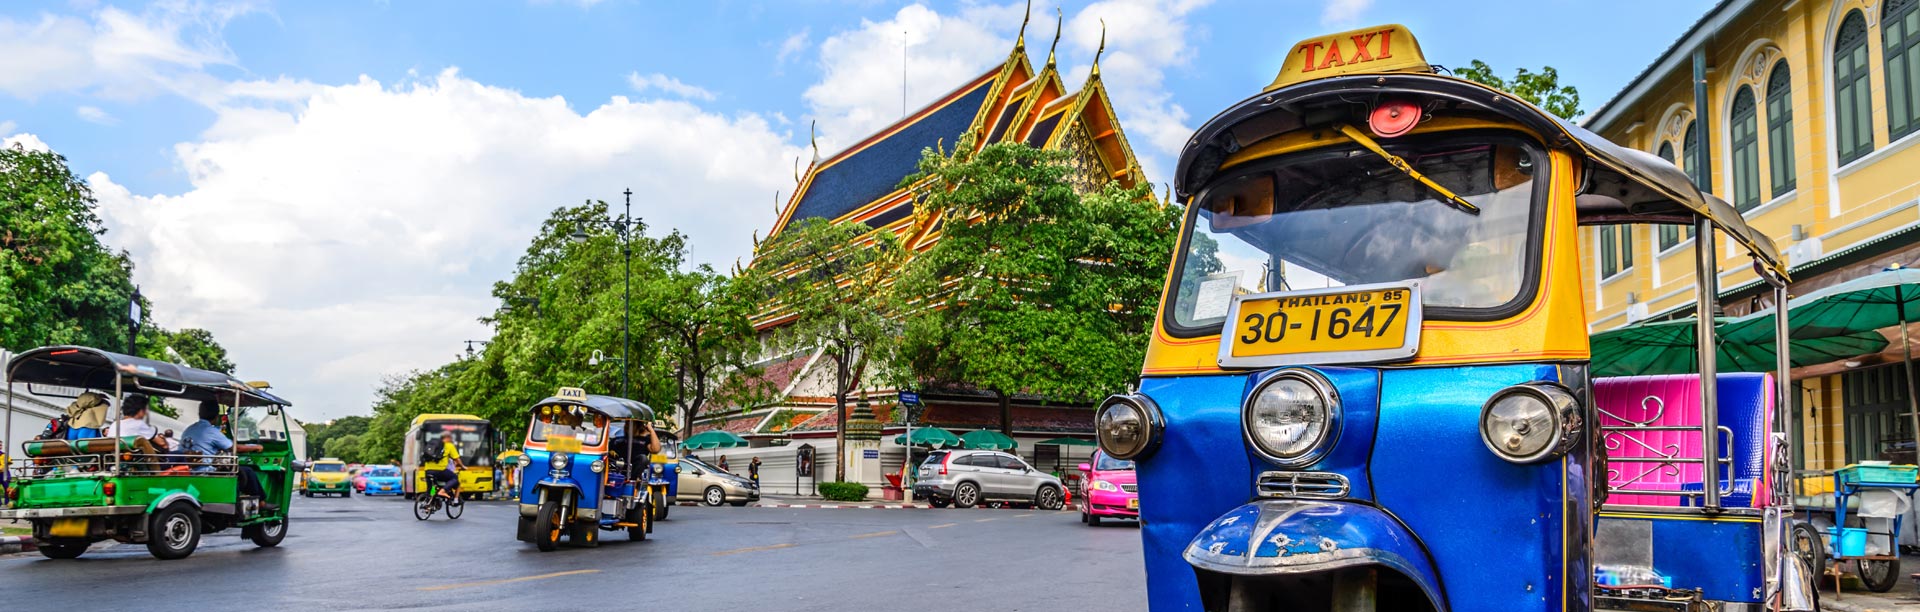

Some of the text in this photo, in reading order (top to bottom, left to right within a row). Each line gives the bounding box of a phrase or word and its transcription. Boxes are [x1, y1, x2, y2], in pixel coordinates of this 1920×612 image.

[1298, 29, 1395, 72] TAXI
[1277, 290, 1402, 309] THAILAND 85
[1241, 304, 1402, 345] 30-1647
[562, 388, 582, 398] TAXI
